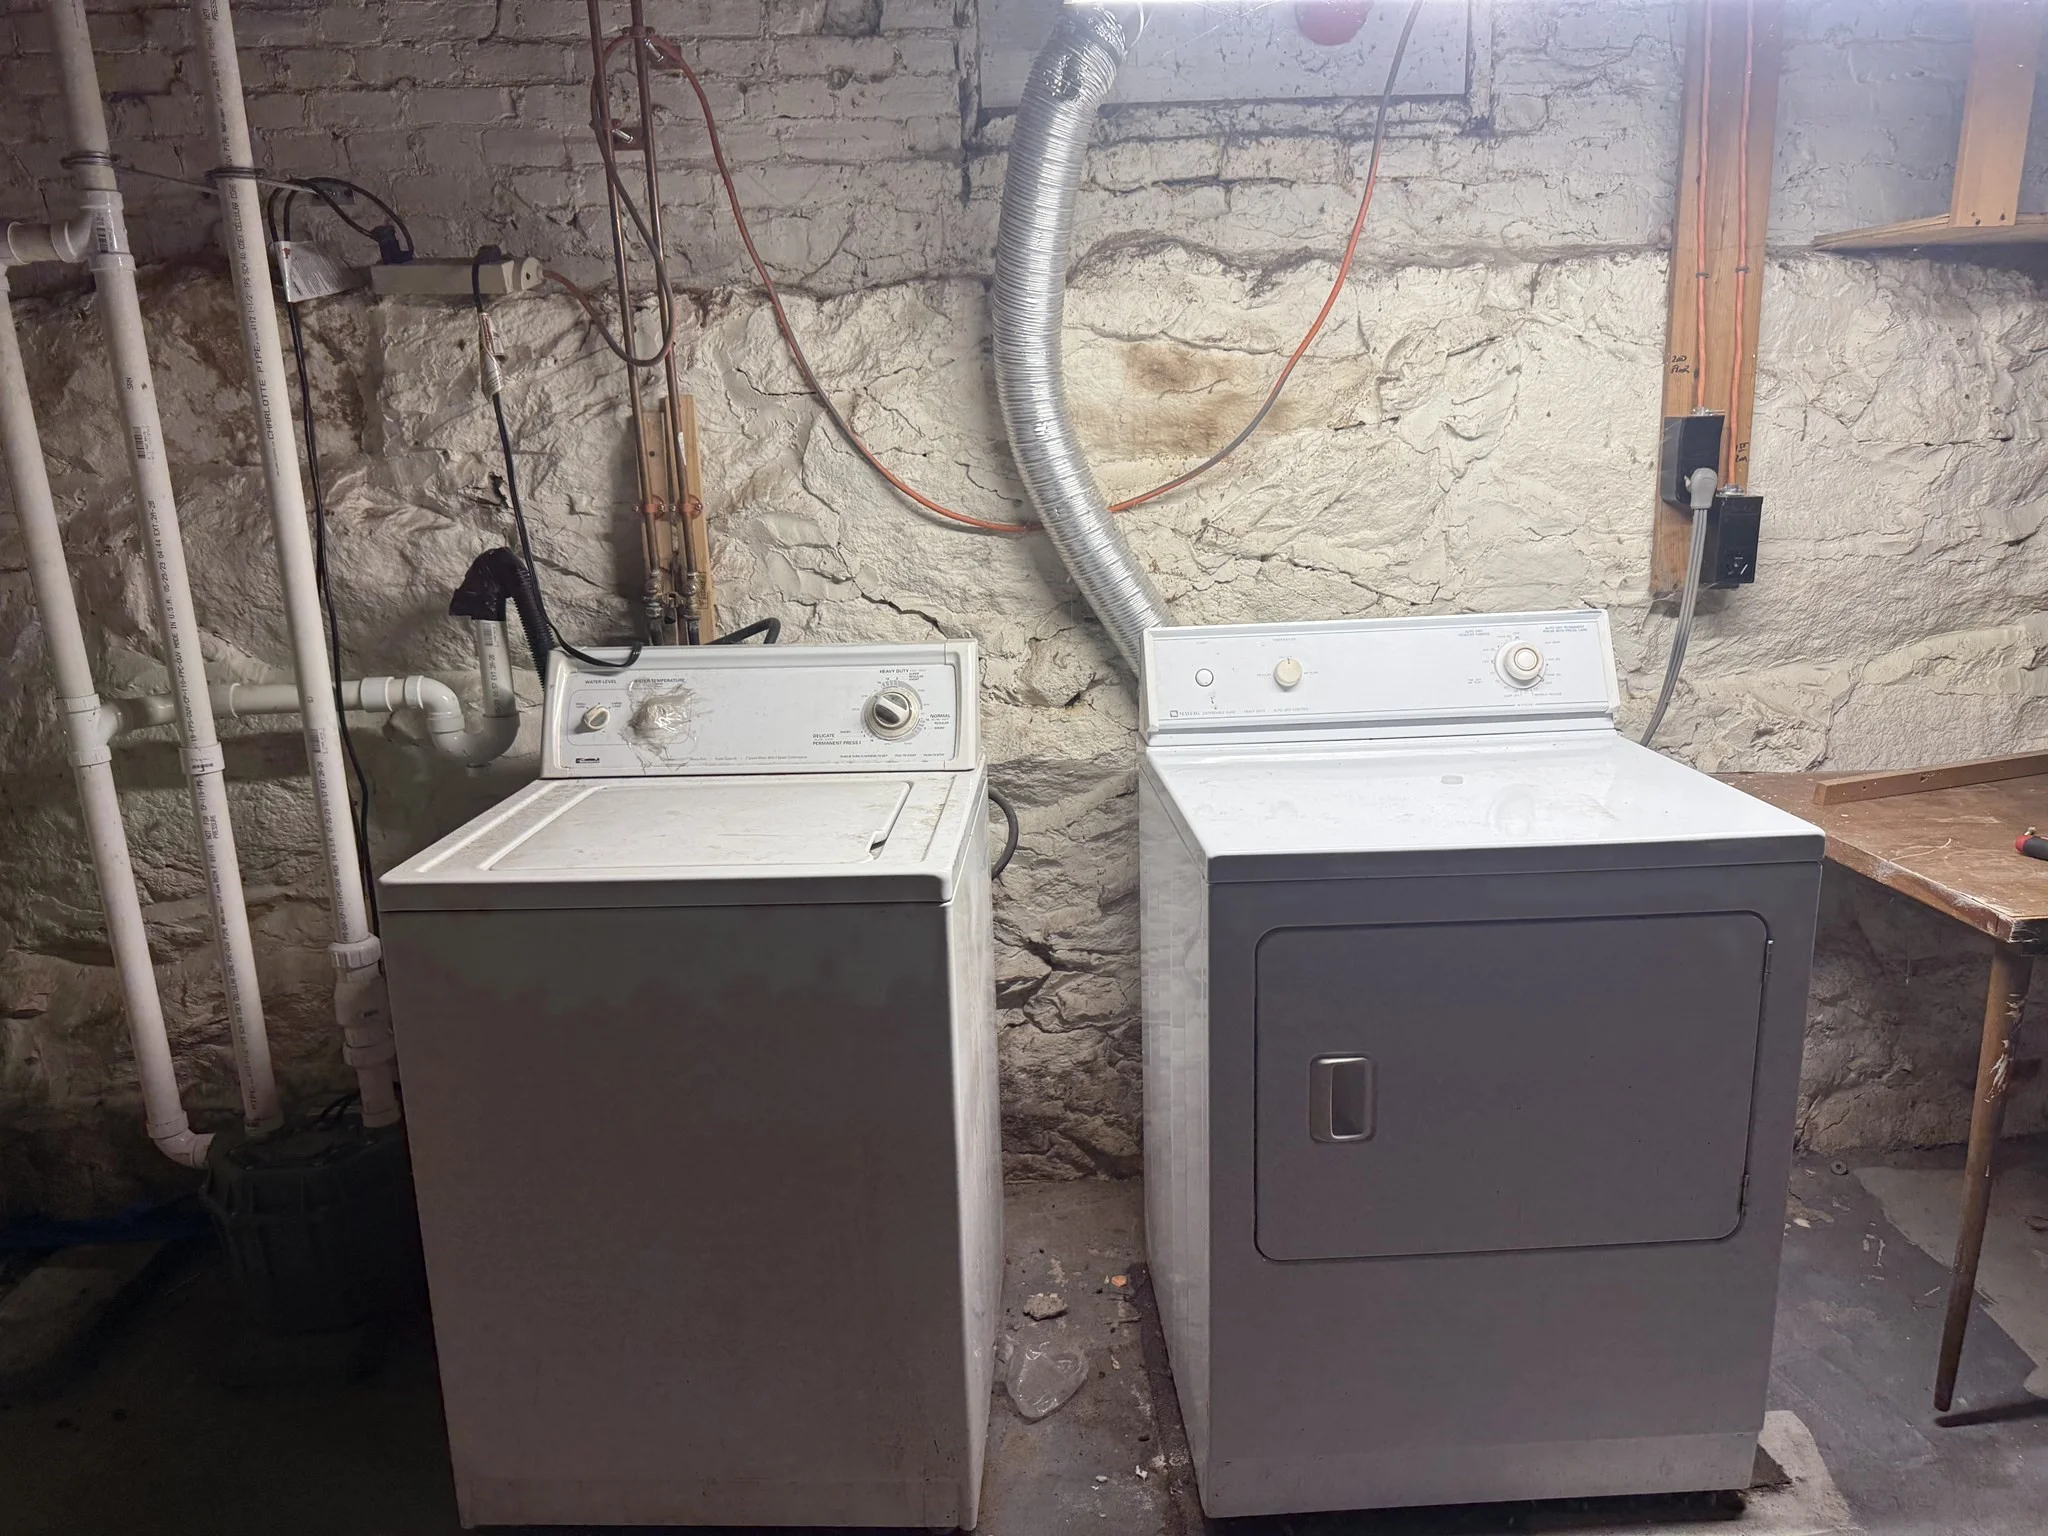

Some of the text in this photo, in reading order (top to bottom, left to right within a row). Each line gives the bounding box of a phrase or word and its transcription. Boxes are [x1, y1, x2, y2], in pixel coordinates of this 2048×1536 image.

[221, 136, 230, 152] PIPE
[228, 183, 238, 199] CORE
[231, 201, 243, 232] CELLULAR
[241, 262, 249, 275] SCH
[253, 343, 263, 373] PIPE
[258, 379, 274, 440] CHARLOTTE
[170, 621, 177, 629] IN
[202, 815, 210, 825] FOR
[209, 814, 219, 839] PRESSURE
[204, 830, 212, 840] NOT
[331, 854, 337, 862] IN
[230, 977, 239, 1002] CELLULAR
